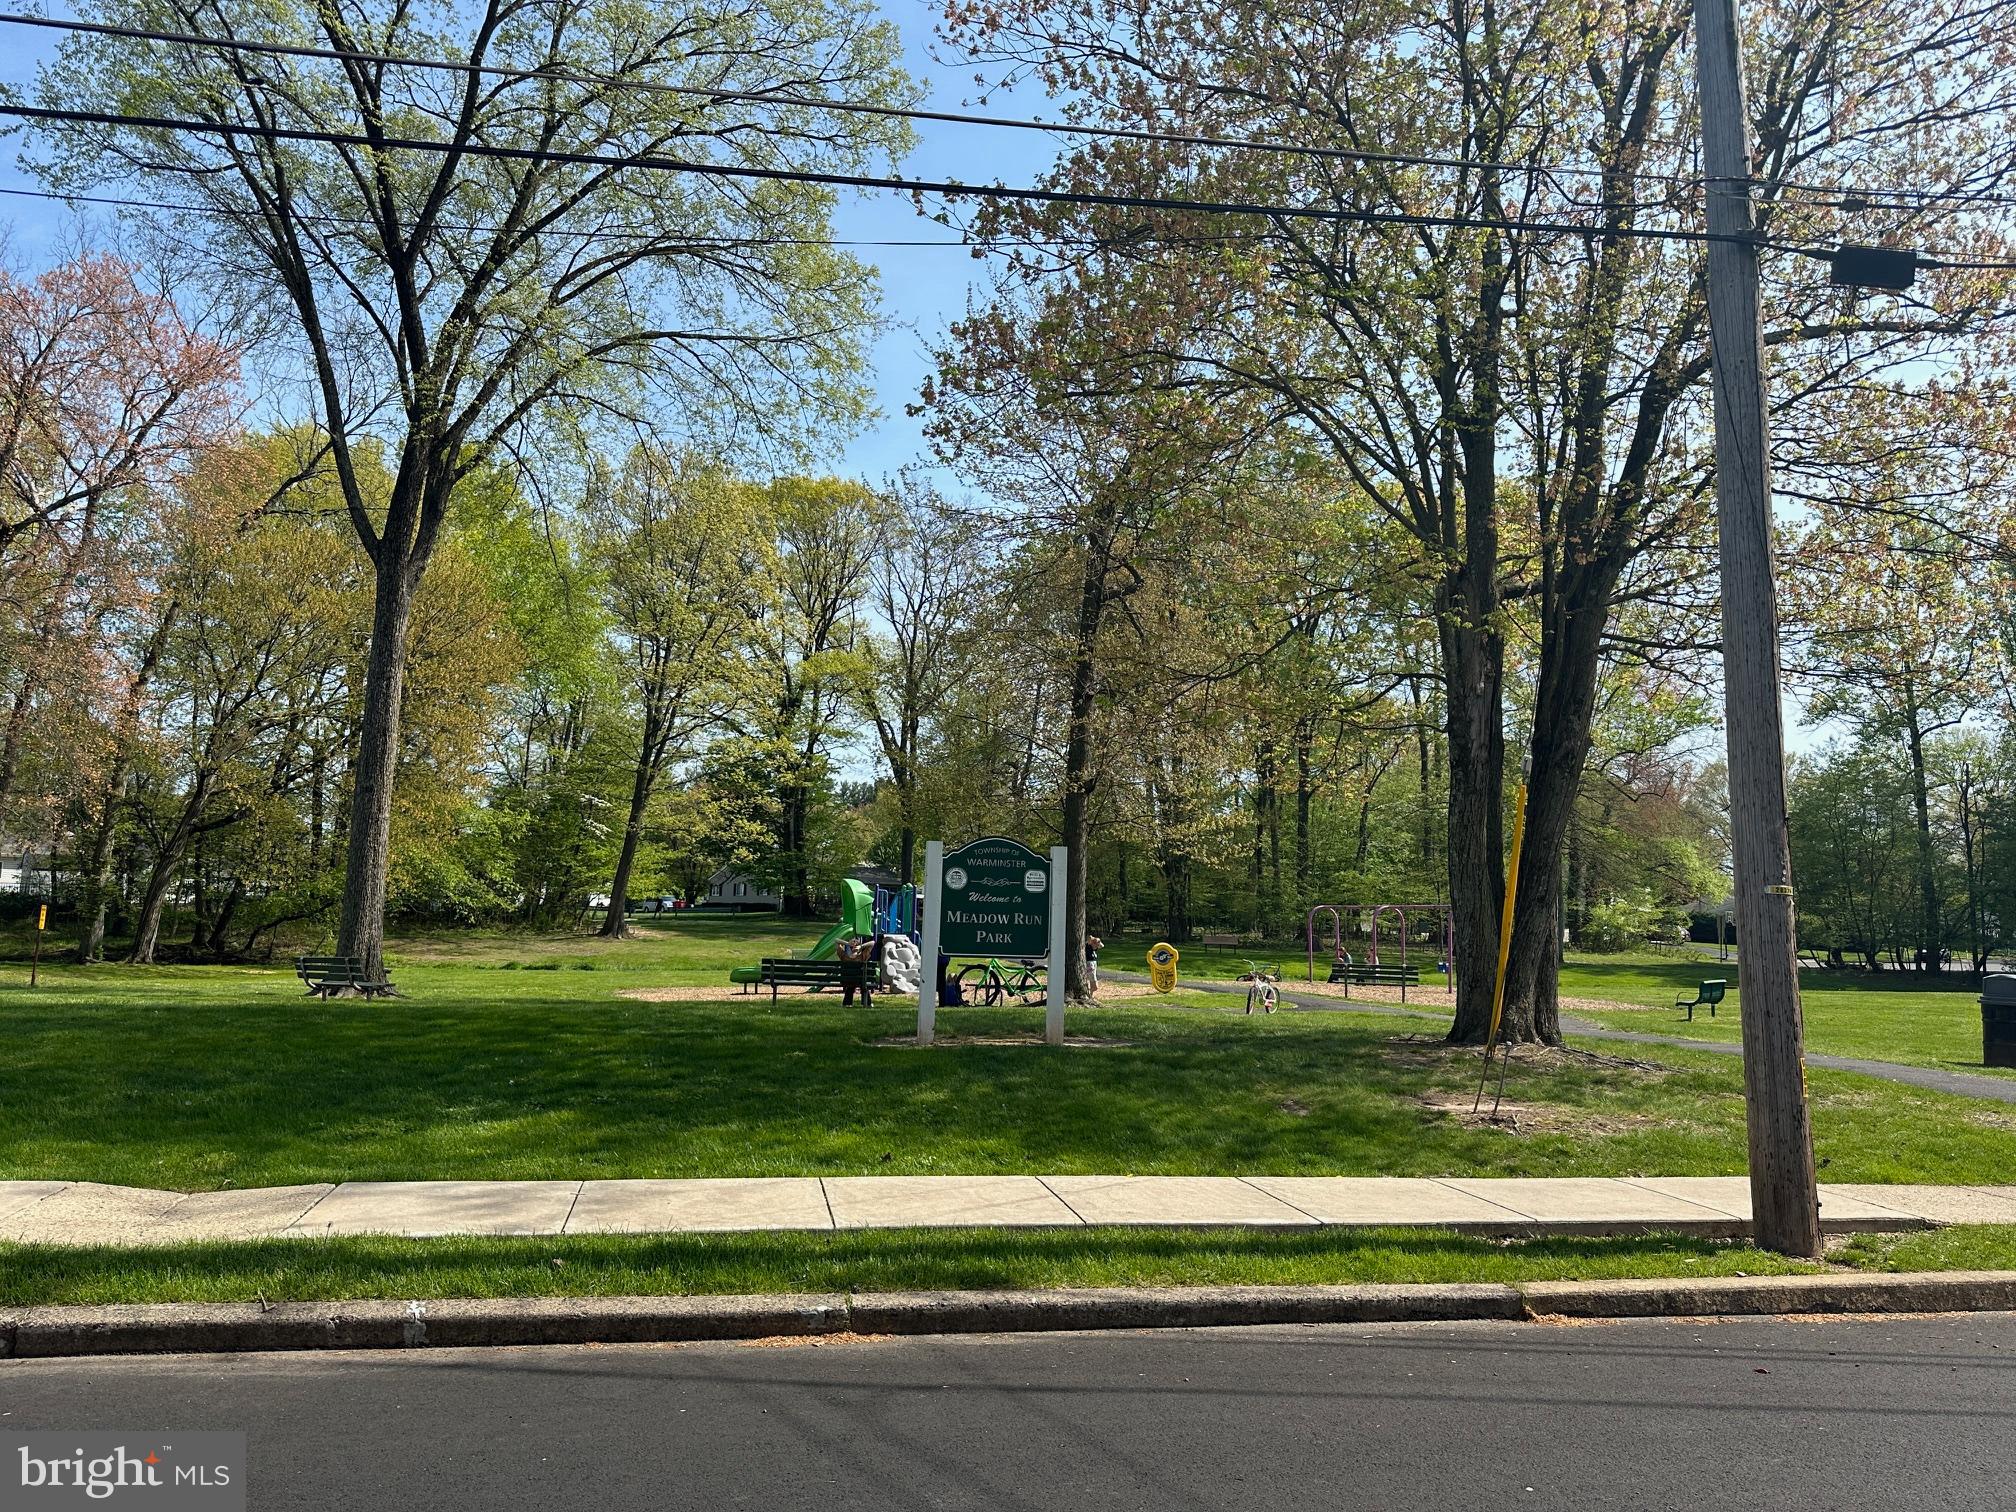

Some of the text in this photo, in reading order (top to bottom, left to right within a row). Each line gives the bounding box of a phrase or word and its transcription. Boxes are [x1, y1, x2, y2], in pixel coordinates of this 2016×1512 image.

[974, 847, 1010, 856] TOWNSHIP
[967, 858, 1027, 868] WARMINSTER
[968, 891, 1022, 903] Welcome to
[946, 910, 1042, 926] MEADOW RUN
[976, 930, 1012, 944] PARK
